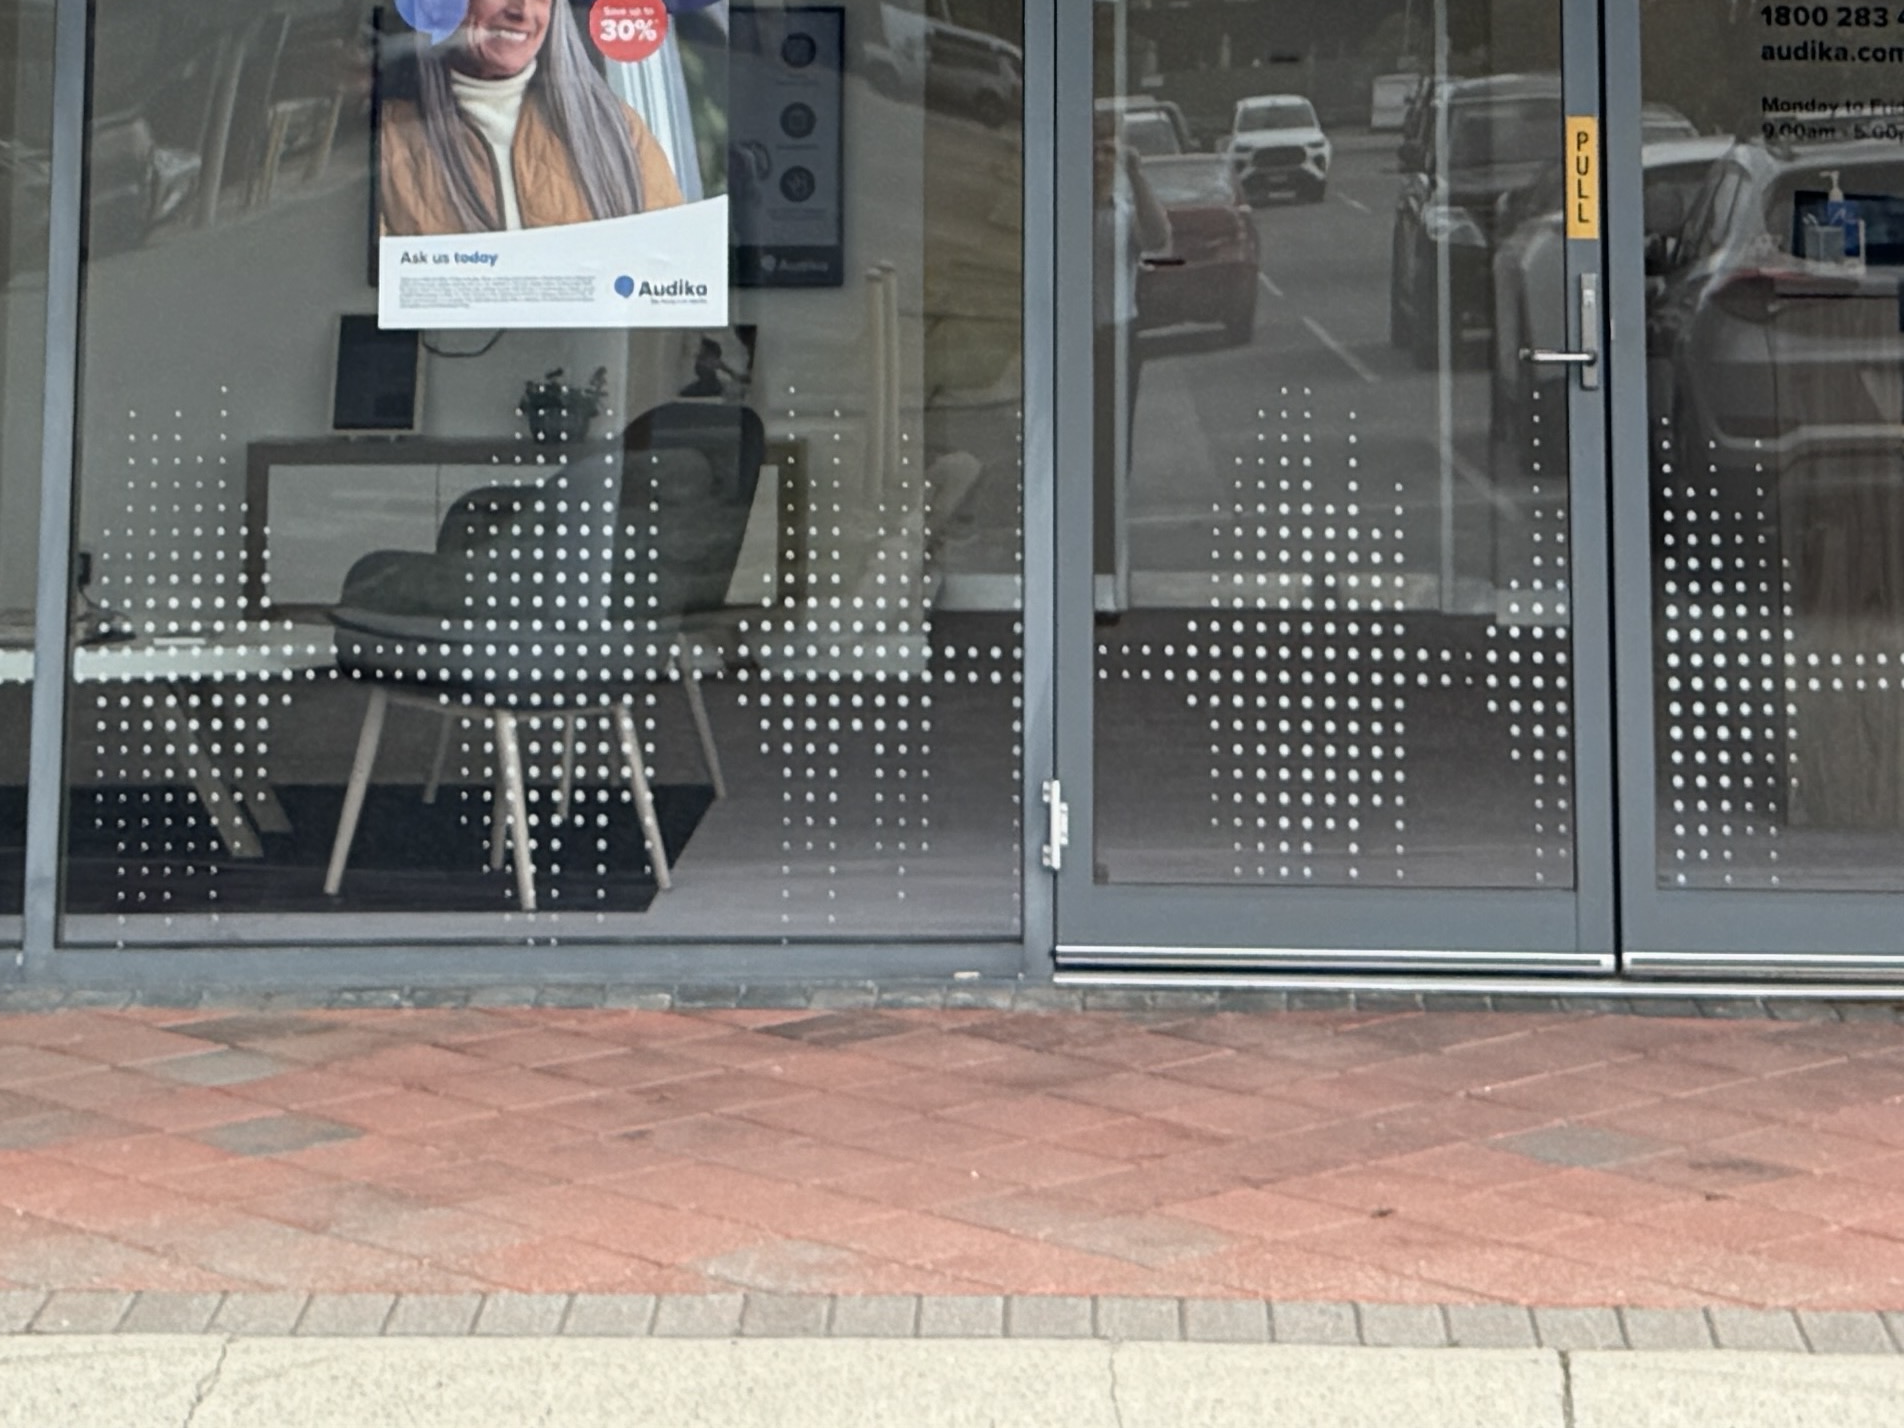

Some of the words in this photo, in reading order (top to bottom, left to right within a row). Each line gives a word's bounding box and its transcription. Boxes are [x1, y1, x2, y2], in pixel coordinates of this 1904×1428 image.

[1761, 6, 1829, 29] 1800
[1836, 6, 1889, 29] 283
[1761, 96, 1839, 119] Monday
[1845, 98, 1864, 115] to
[1576, 131, 1591, 225] PULL
[400, 250, 428, 265] Ask
[432, 254, 449, 265] us
[453, 251, 499, 268] today
[637, 277, 708, 297] Audika
